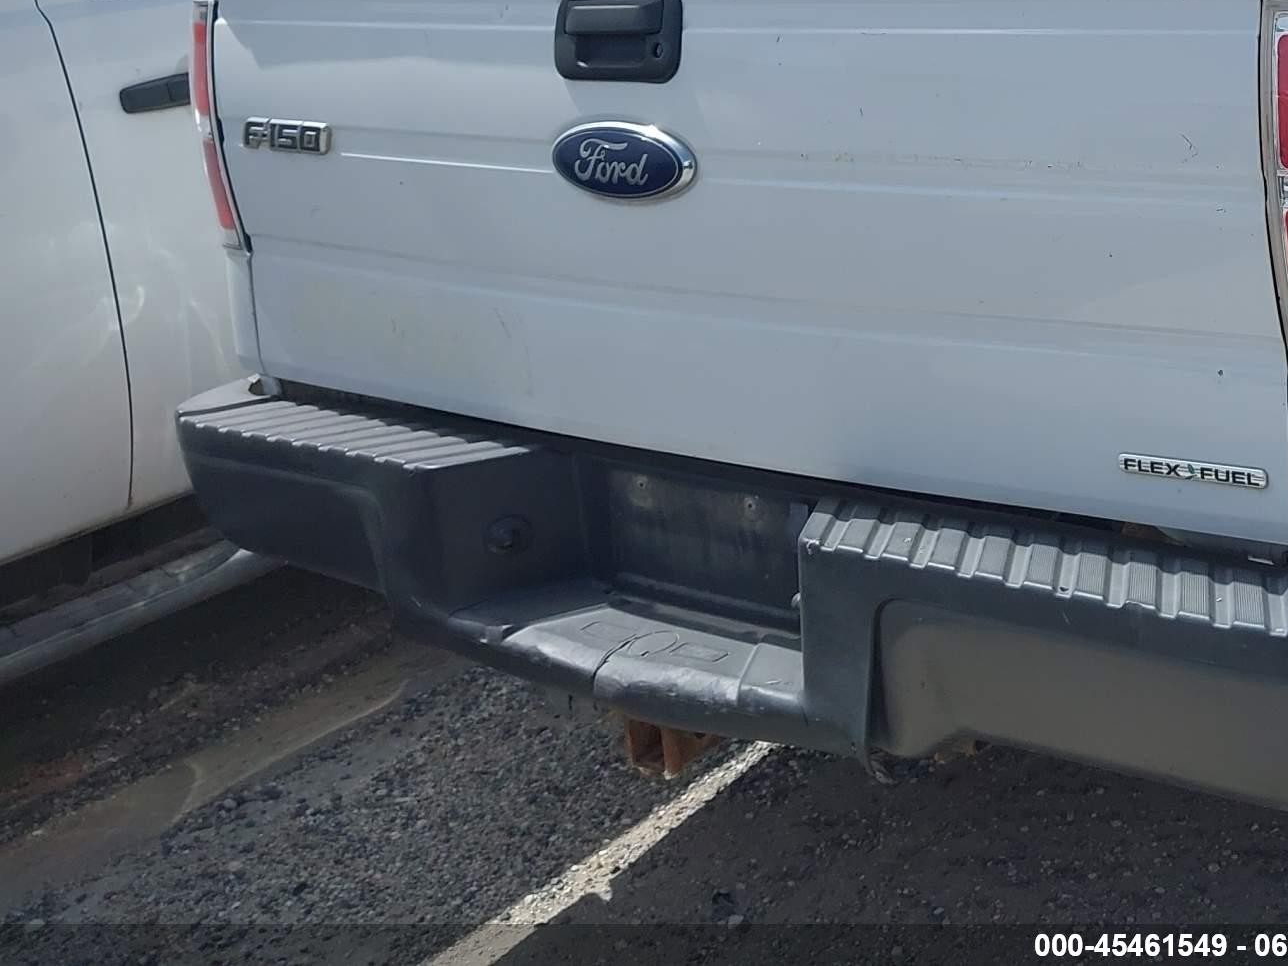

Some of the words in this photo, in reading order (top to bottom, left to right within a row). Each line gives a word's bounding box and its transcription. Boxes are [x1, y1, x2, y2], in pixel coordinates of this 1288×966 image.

[243, 116, 332, 156] F-150
[574, 138, 649, 185] Ford
[1123, 457, 1181, 477] FLEX
[1199, 467, 1260, 487] FUEL
